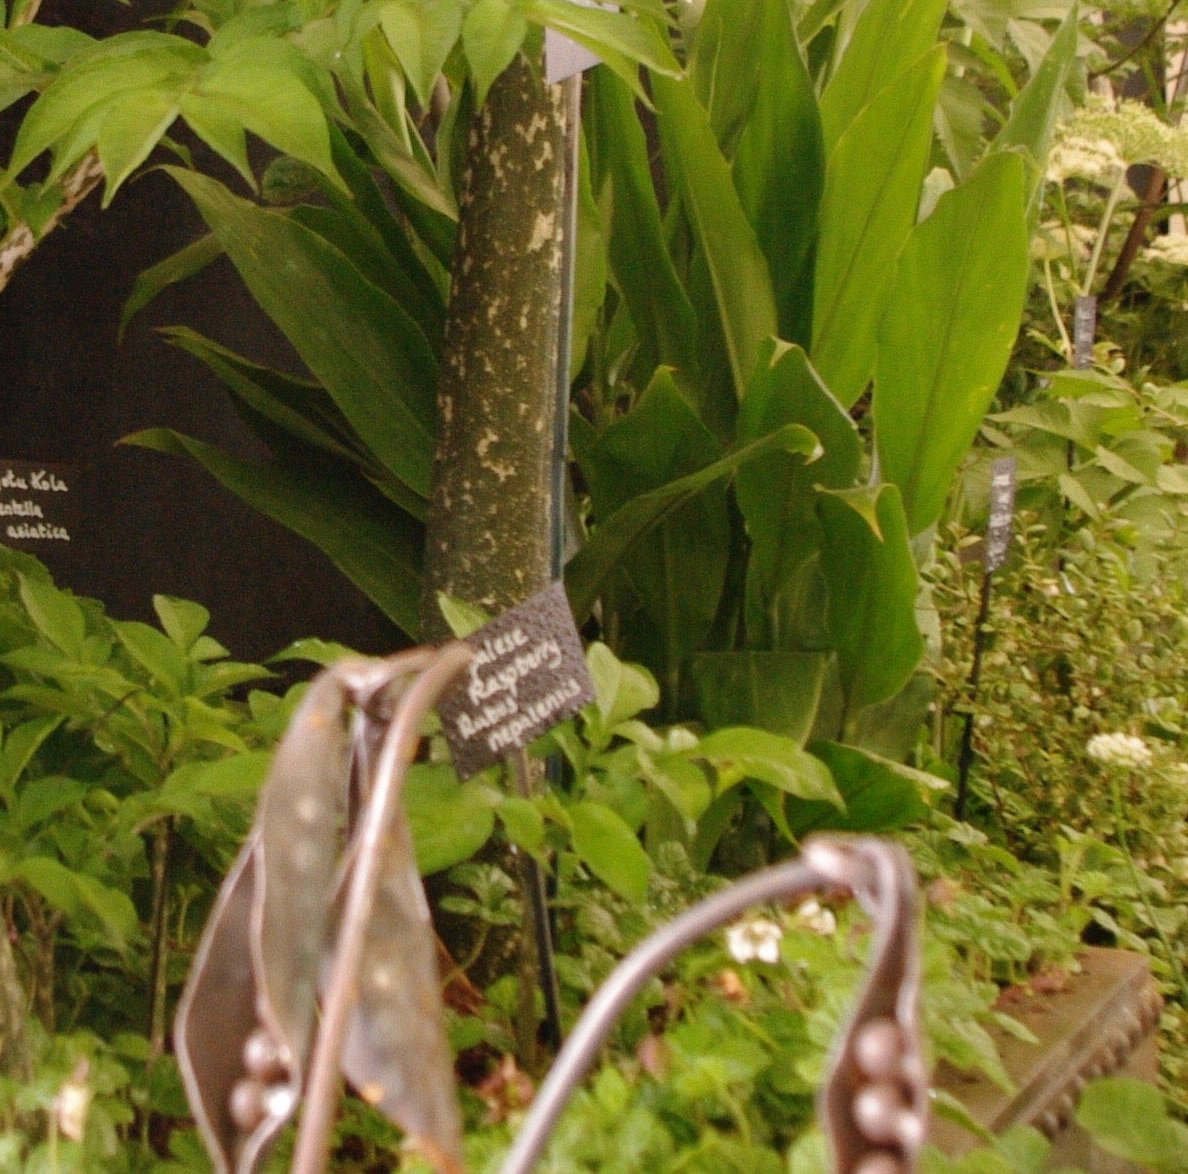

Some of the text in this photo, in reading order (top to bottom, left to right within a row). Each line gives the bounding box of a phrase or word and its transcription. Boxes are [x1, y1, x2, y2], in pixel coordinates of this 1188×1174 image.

[31, 469, 69, 492] Kola
[7, 522, 71, 541] asiatica
[468, 638, 563, 707] Raspberry
[456, 696, 519, 740] Rubus
[488, 677, 582, 752] nepalensis
